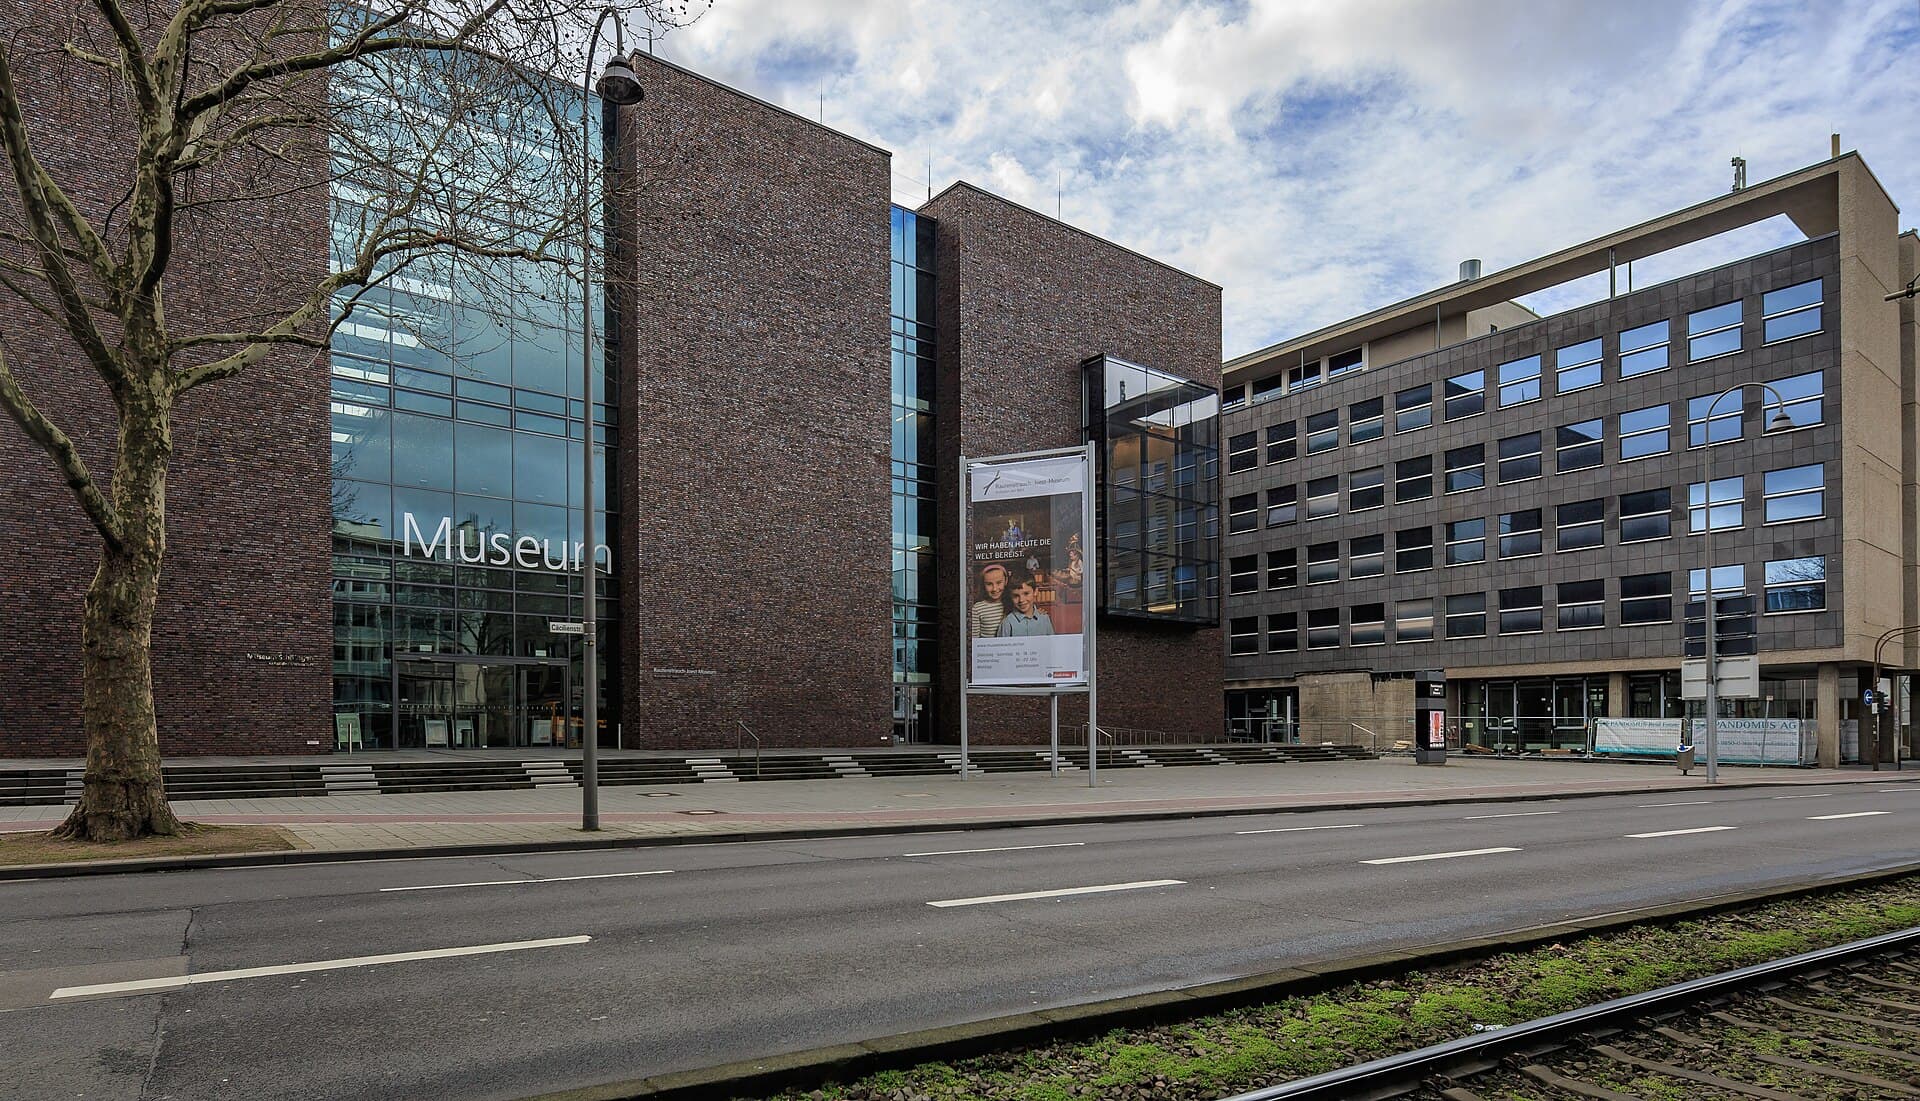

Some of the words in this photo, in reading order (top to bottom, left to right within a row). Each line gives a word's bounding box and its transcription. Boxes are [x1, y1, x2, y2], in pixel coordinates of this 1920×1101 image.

[403, 512, 612, 574] Museum
[975, 552, 993, 560] WELT
[994, 550, 1025, 558] BEREIST.
[1717, 721, 1776, 729] ANDOMUS
[1780, 721, 1797, 729] AG
